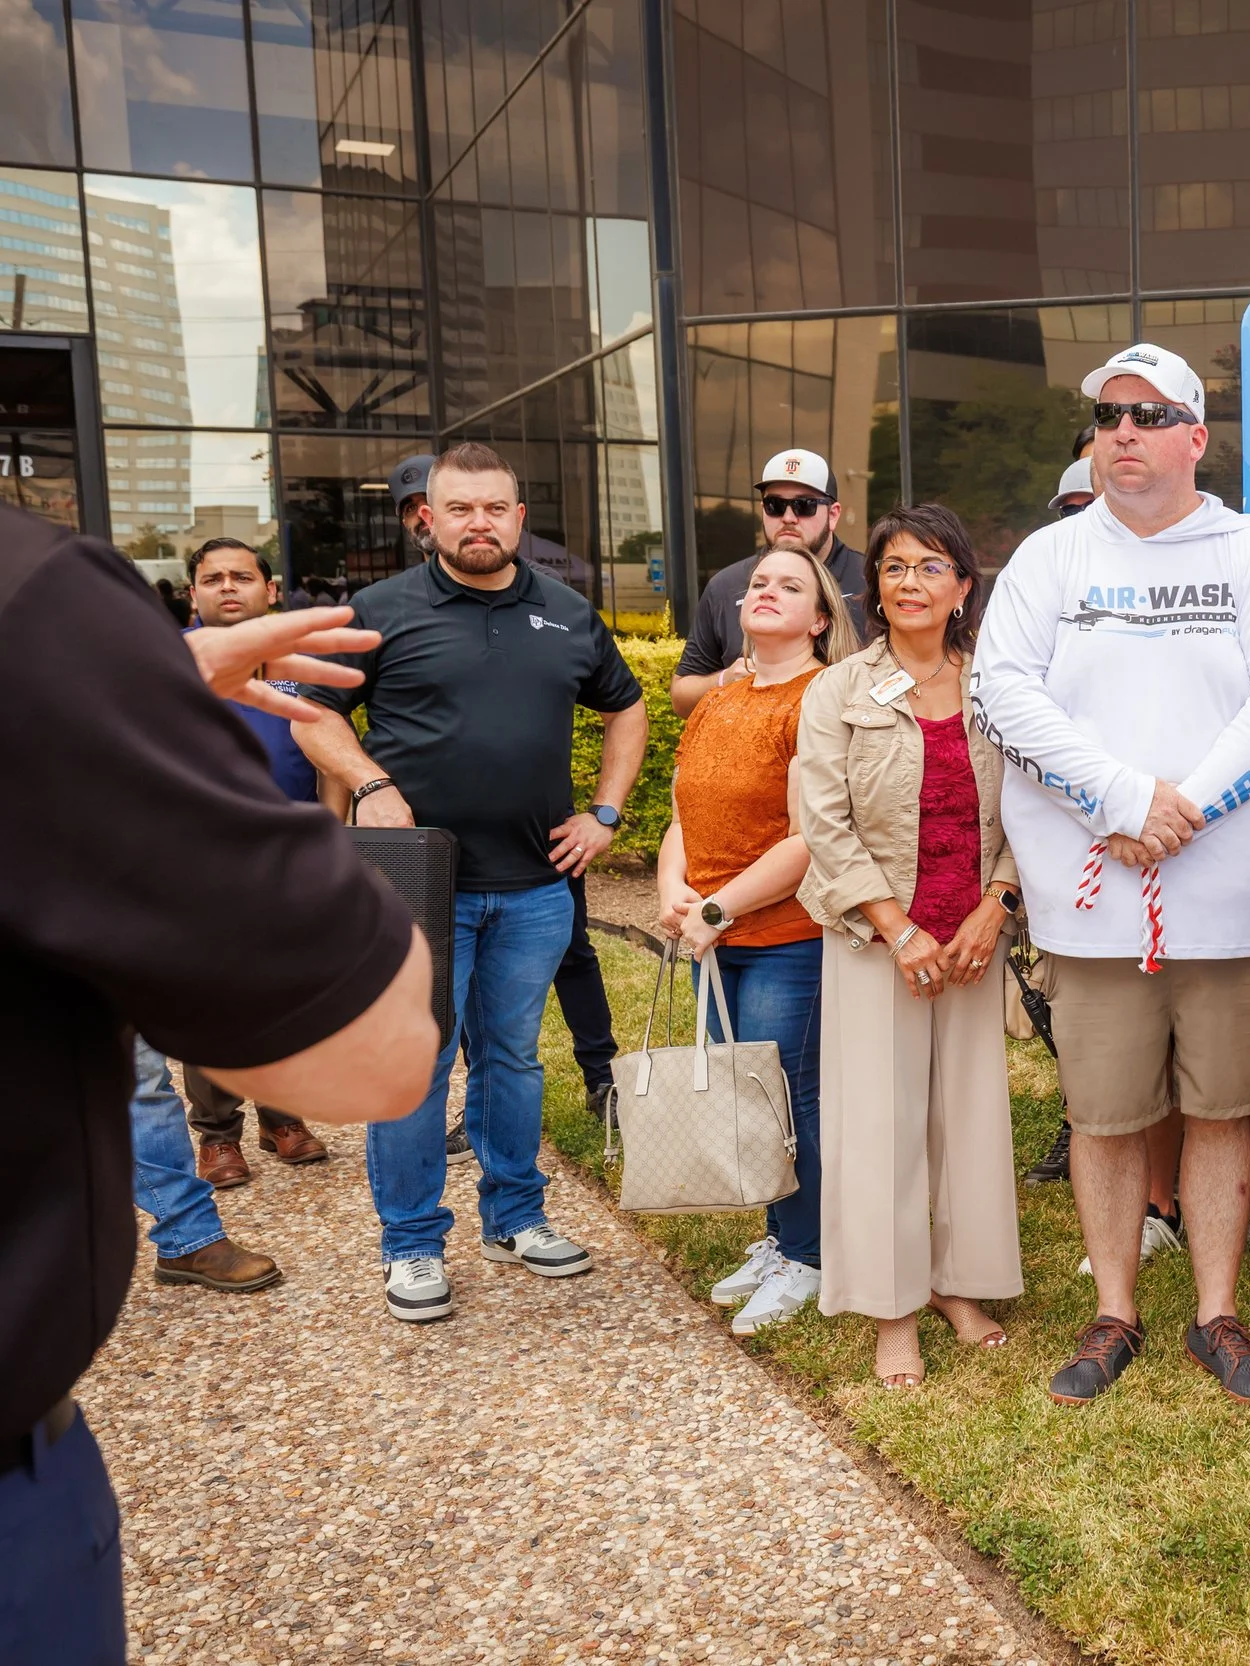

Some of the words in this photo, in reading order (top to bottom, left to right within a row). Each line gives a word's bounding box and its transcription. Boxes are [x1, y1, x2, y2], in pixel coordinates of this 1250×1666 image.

[1139, 614, 1182, 624] HEIGHTS
[1188, 613, 1236, 622] CLEANIN
[1171, 628, 1181, 636] BY
